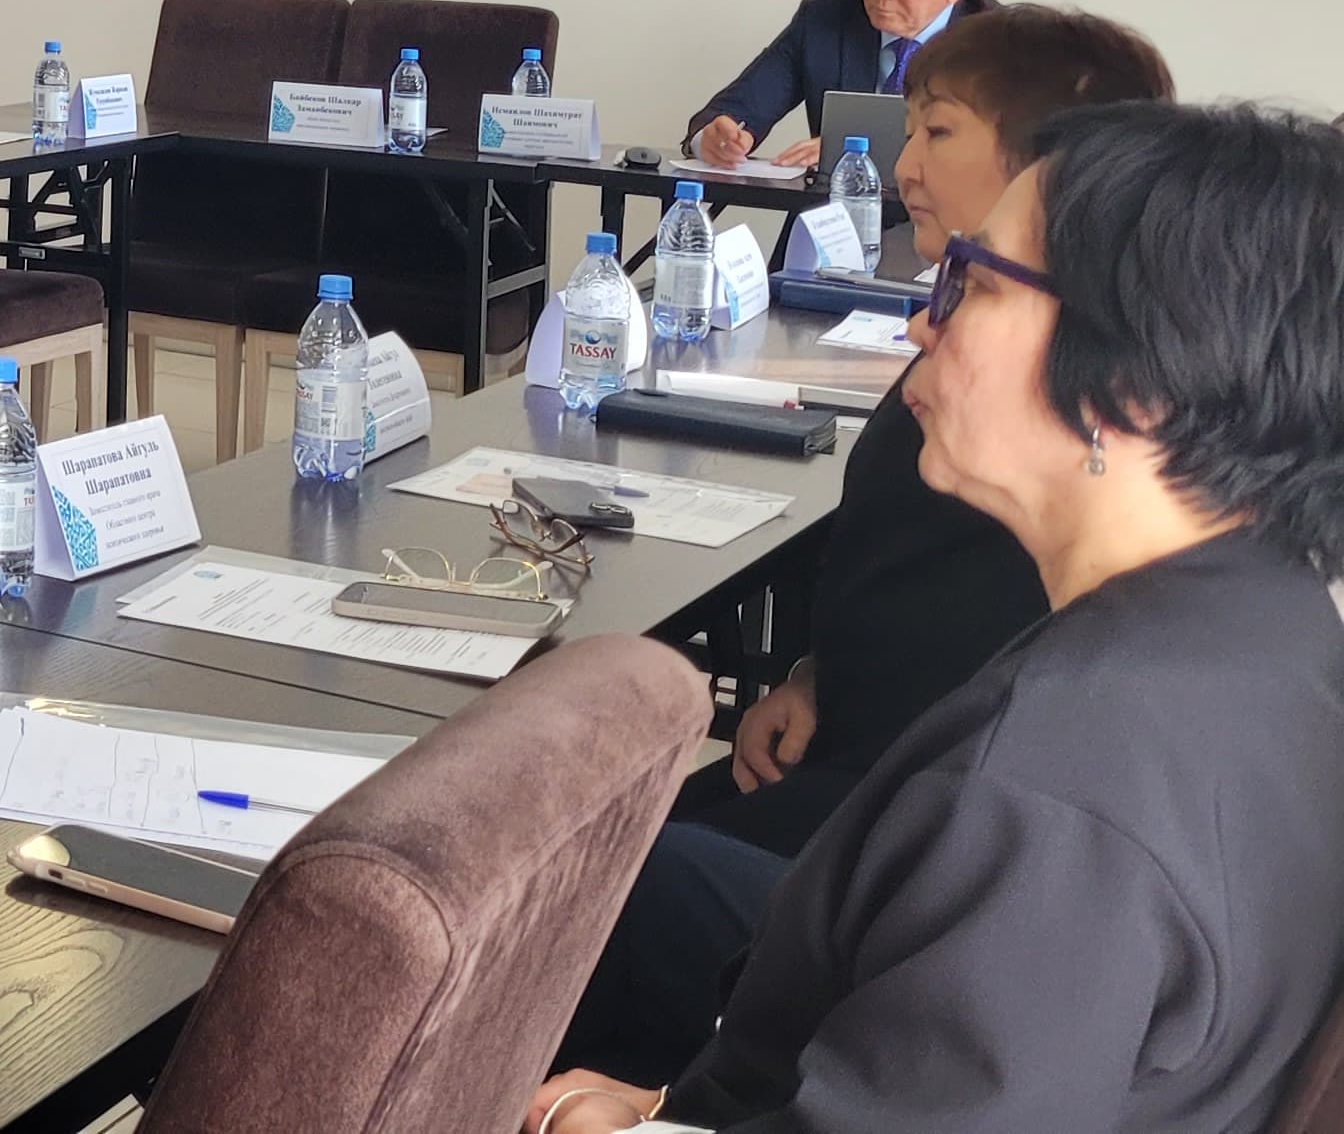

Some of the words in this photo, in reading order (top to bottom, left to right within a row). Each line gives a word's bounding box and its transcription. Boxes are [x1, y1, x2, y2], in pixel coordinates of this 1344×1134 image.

[569, 342, 617, 360] TASSAY
[62, 450, 123, 475] Шарапатова
[125, 441, 160, 459] Айгуль
[85, 467, 152, 496] Шарапатовна
